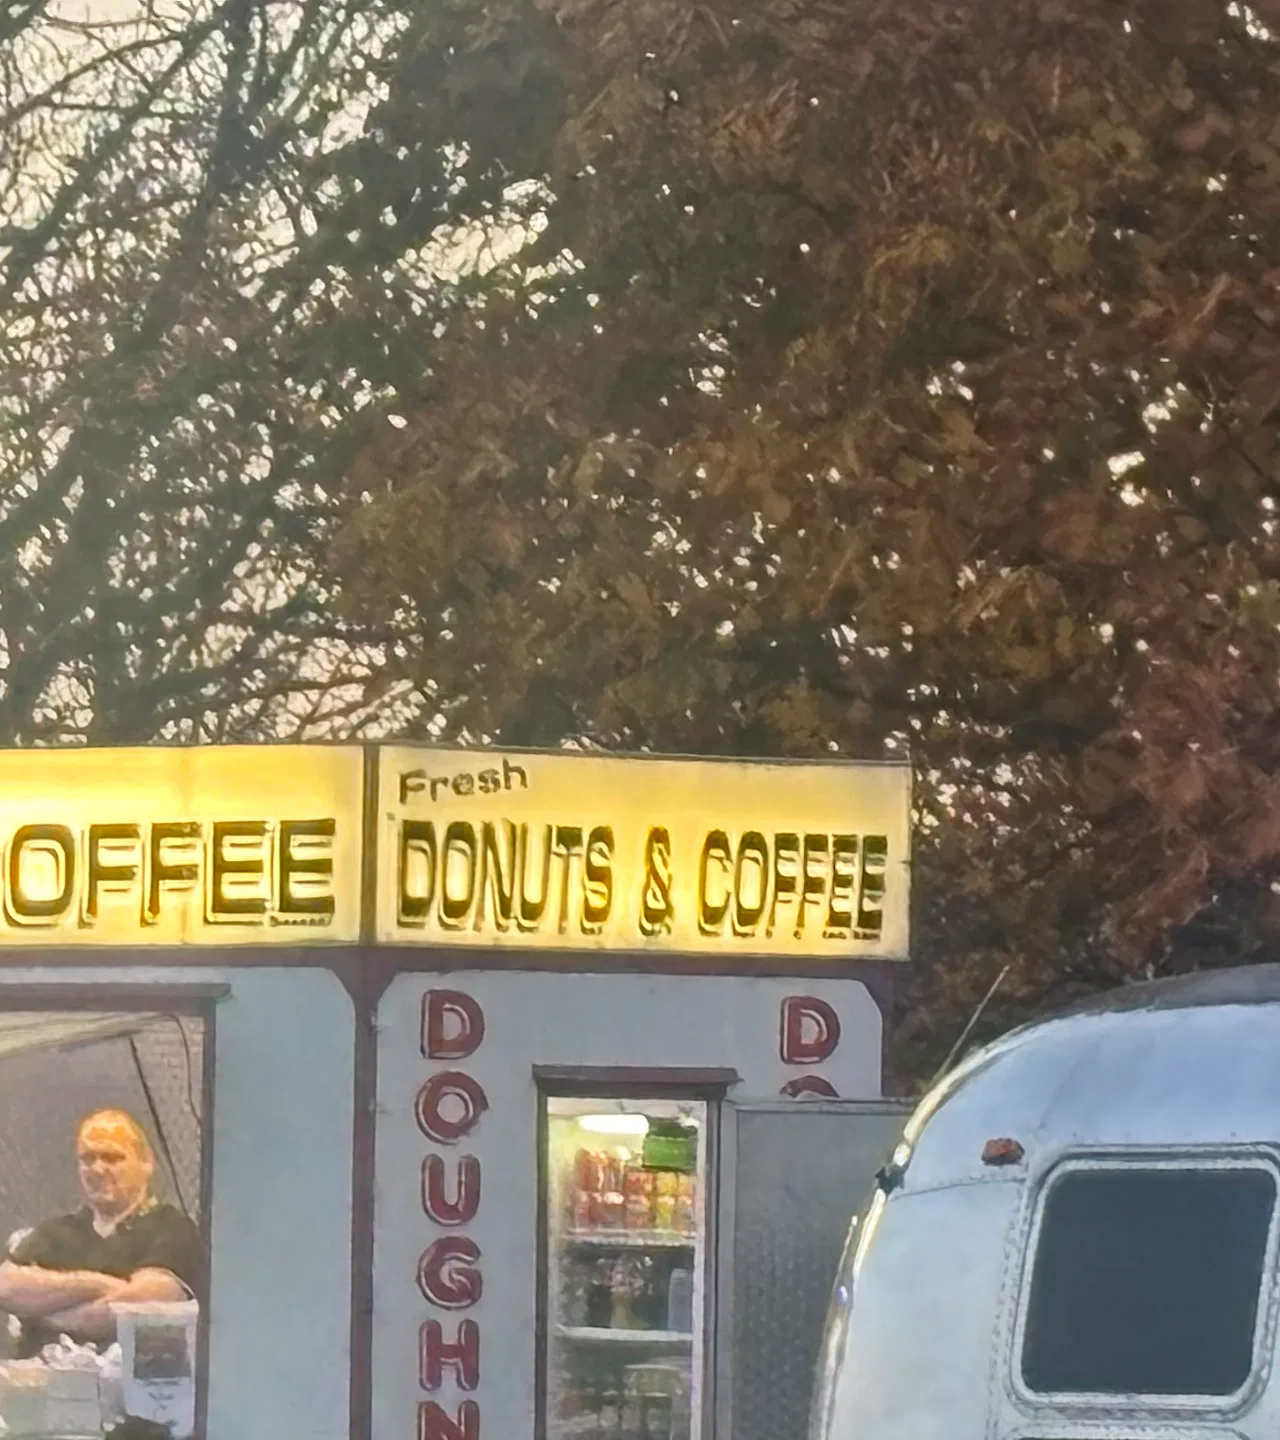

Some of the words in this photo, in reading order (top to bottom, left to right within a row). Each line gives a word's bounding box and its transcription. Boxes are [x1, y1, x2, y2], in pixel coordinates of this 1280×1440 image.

[399, 758, 528, 804] Fresh
[397, 818, 614, 935] DONUTS
[639, 825, 673, 936] &
[697, 828, 888, 939] COFFEE
